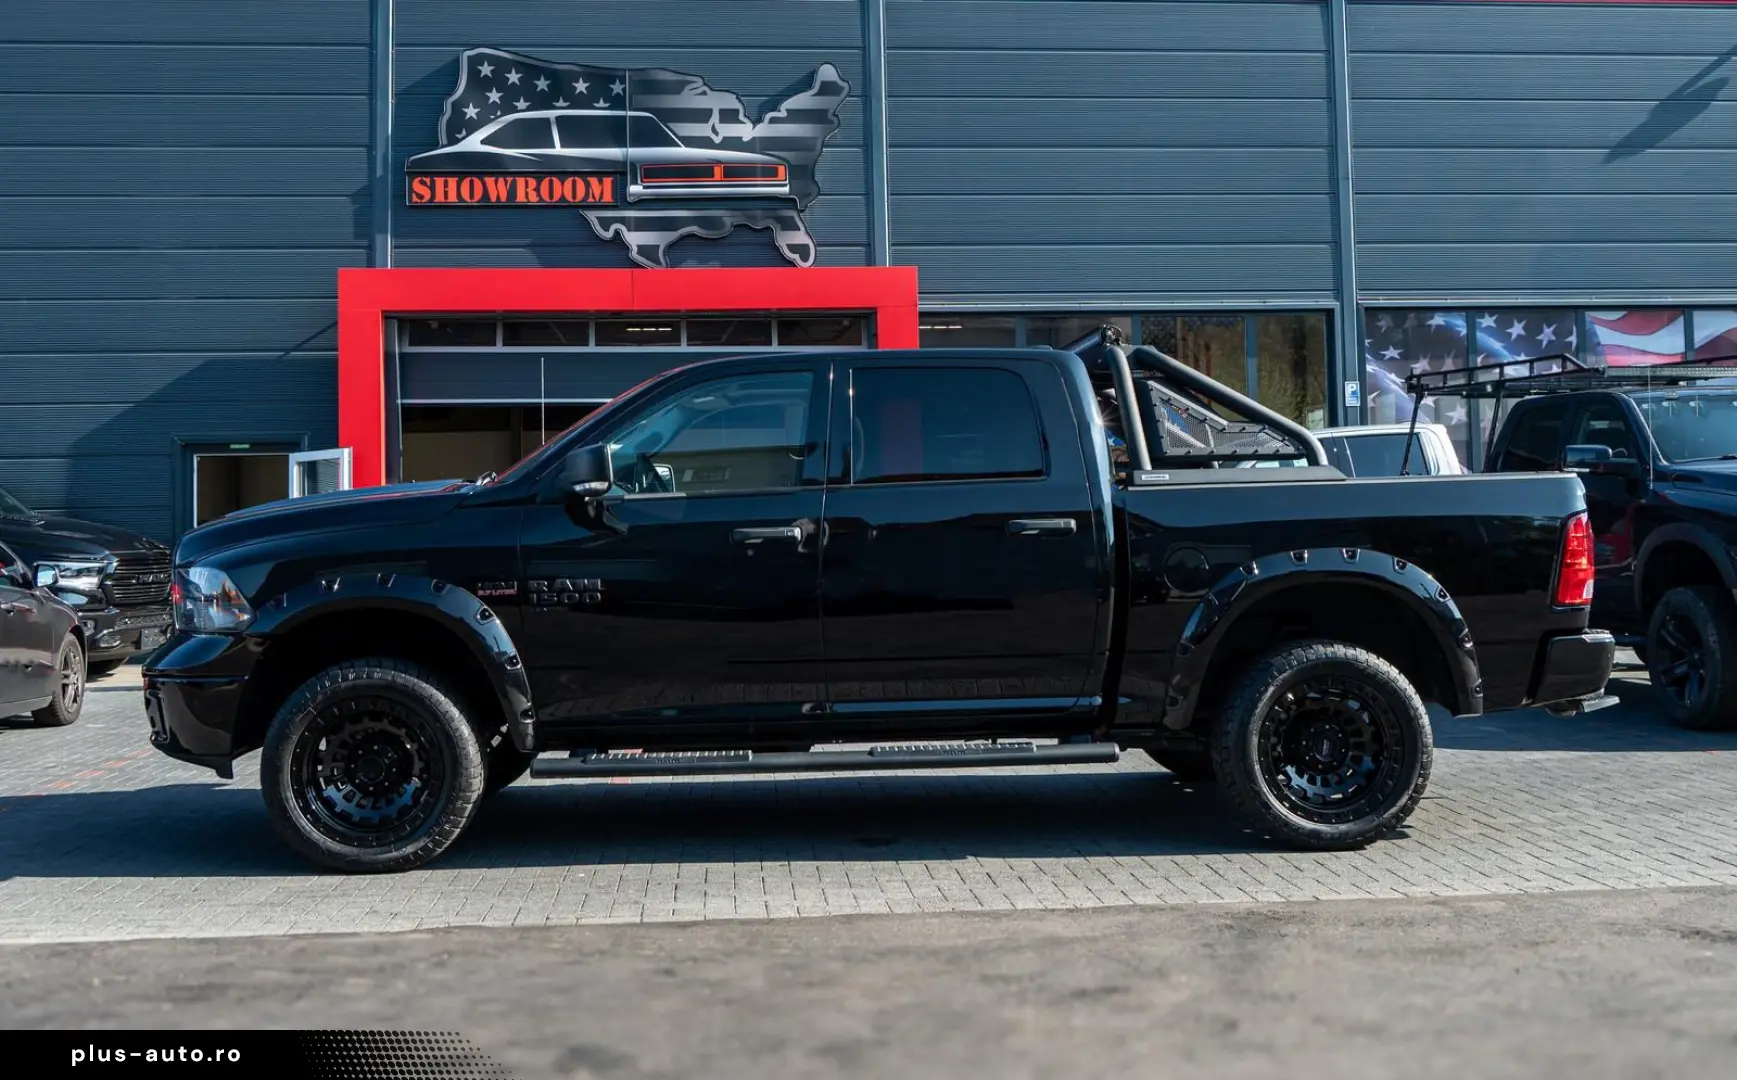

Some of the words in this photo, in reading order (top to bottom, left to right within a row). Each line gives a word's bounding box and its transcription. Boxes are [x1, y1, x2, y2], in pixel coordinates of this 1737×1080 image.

[411, 176, 614, 203] SHOWROOM
[528, 578, 602, 592] RAM
[528, 592, 602, 605] 1500
